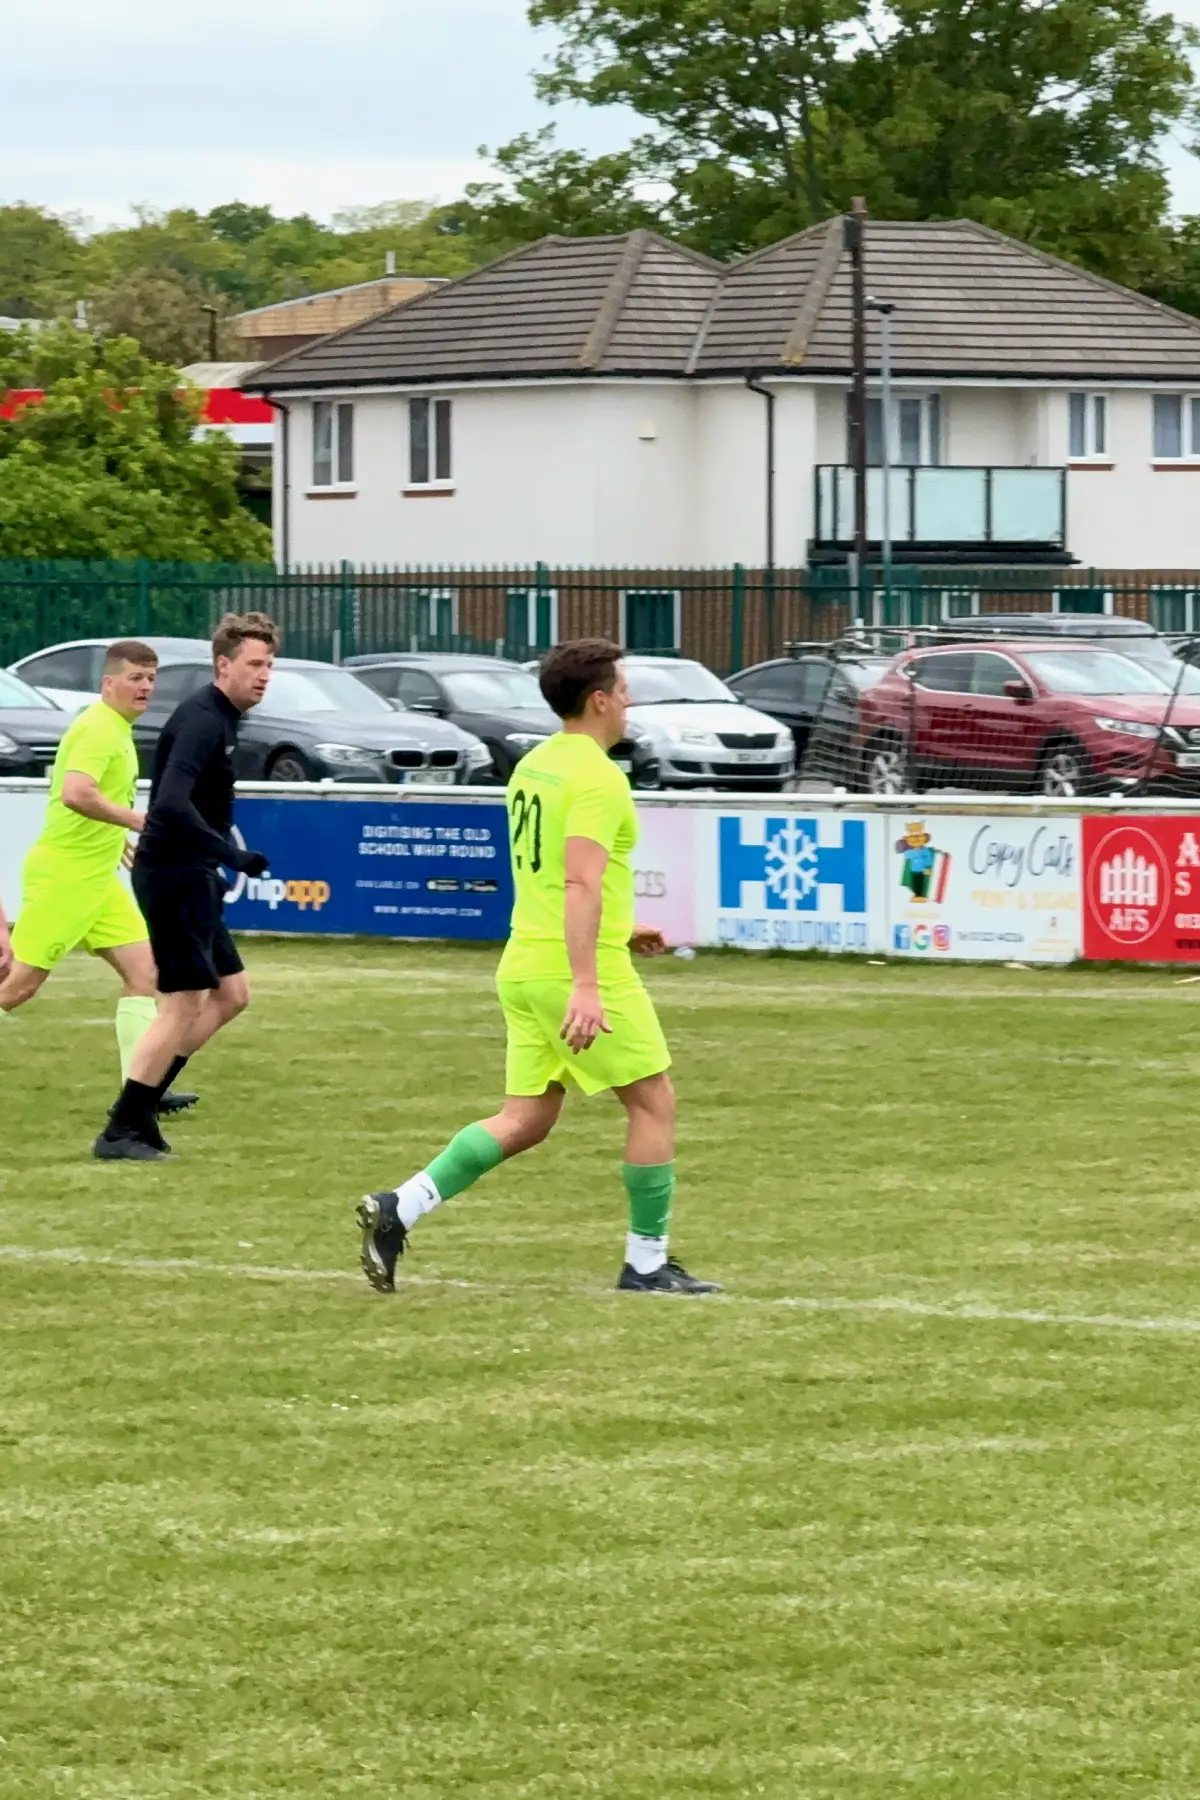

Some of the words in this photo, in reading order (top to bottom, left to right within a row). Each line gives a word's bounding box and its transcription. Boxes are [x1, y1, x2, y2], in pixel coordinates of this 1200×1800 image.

[362, 825, 433, 839] DIGITISING
[434, 827, 461, 840] THE
[463, 828, 491, 841] OLD
[358, 842, 411, 856] SCHOOL
[412, 844, 448, 856] WHIP
[449, 845, 496, 858] ROUND
[1109, 908, 1149, 932] AFS
